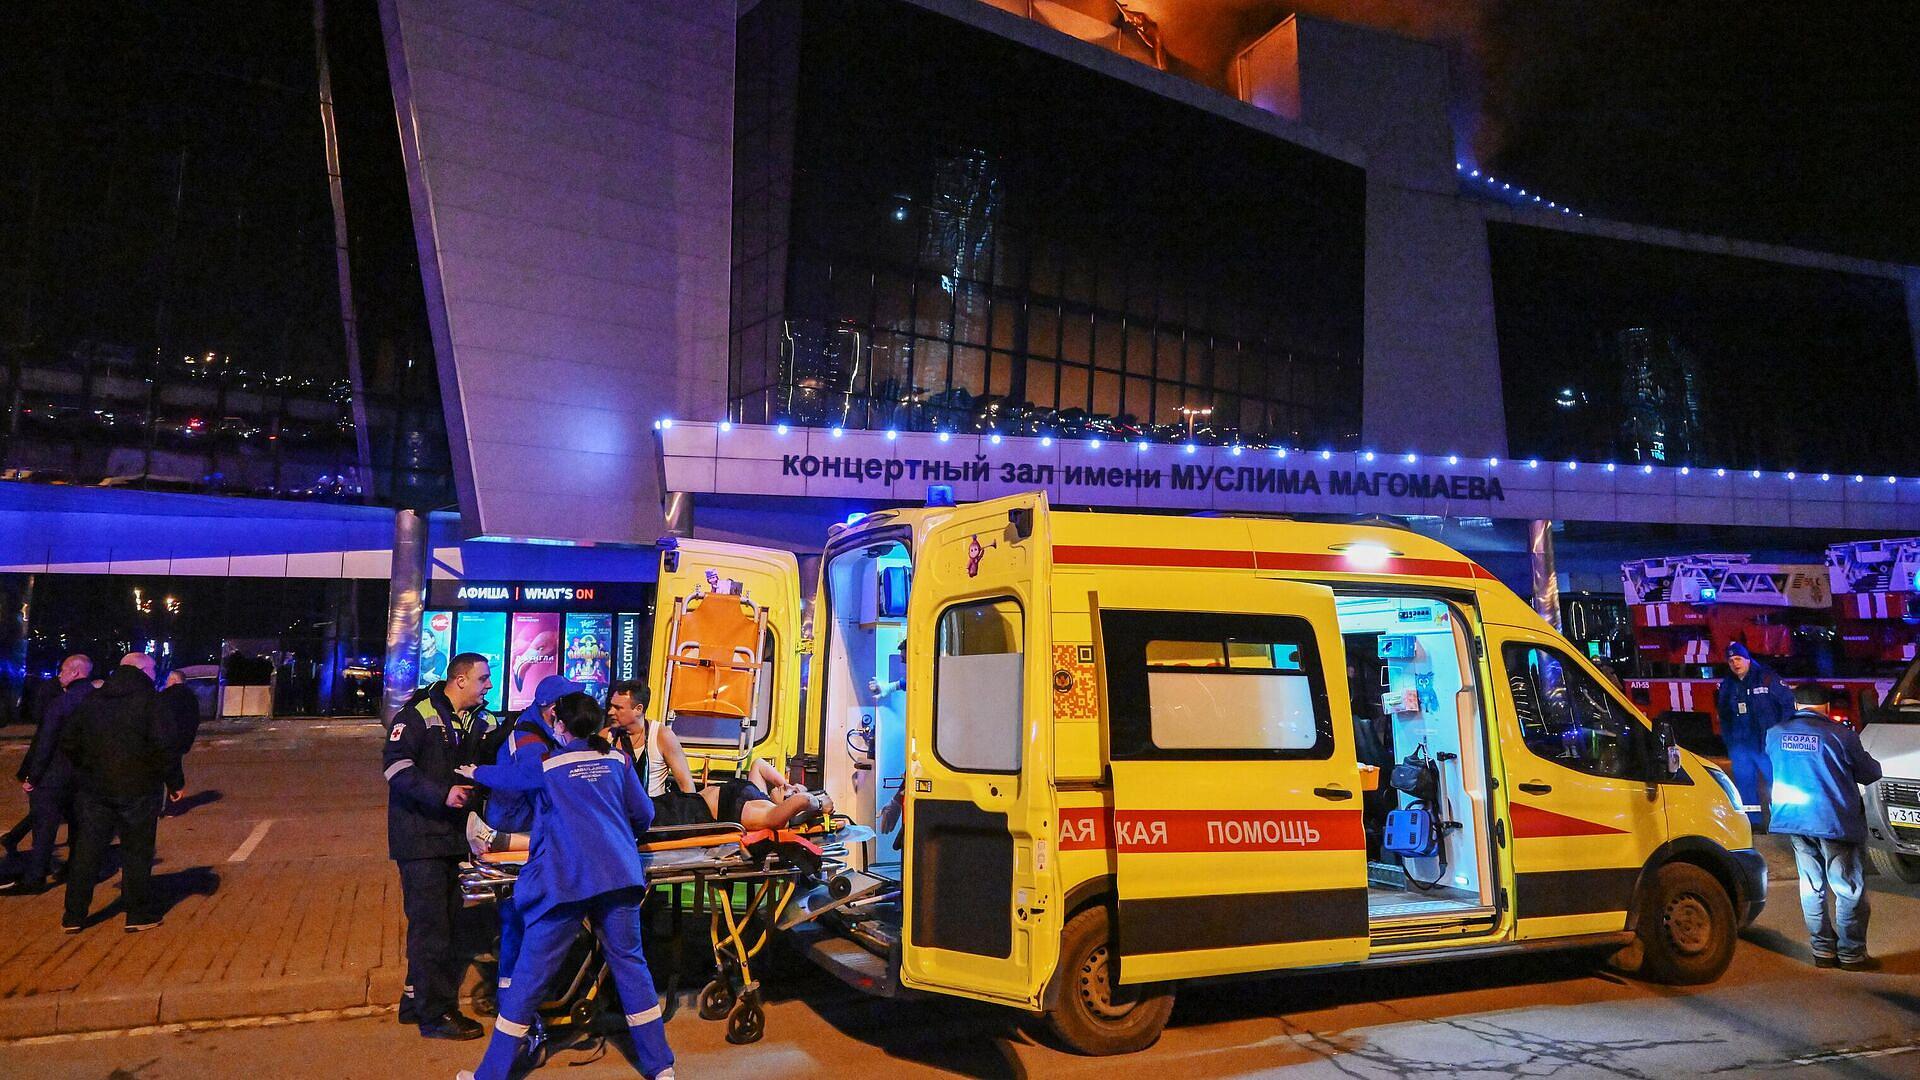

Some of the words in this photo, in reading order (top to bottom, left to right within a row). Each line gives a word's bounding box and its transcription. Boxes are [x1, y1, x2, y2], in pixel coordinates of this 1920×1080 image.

[782, 454, 990, 486] концертный
[999, 461, 1054, 485] зал
[1065, 465, 1161, 488] имени
[1170, 463, 1321, 496] МУСЛИМА
[1329, 470, 1505, 501] МАГОМАЕВА
[457, 586, 510, 599] АФИША
[524, 587, 574, 600] WHAT'S
[575, 588, 594, 600] ON
[624, 618, 634, 643] HALL
[623, 642, 634, 662] CITY
[623, 662, 633, 681] CUS
[1782, 735, 1817, 743] СКОРАЯ
[1782, 742, 1817, 751] ПОМОЩЬ
[1116, 820, 1168, 845] КАЯ
[1206, 820, 1321, 847] ПОМОЩЬ
